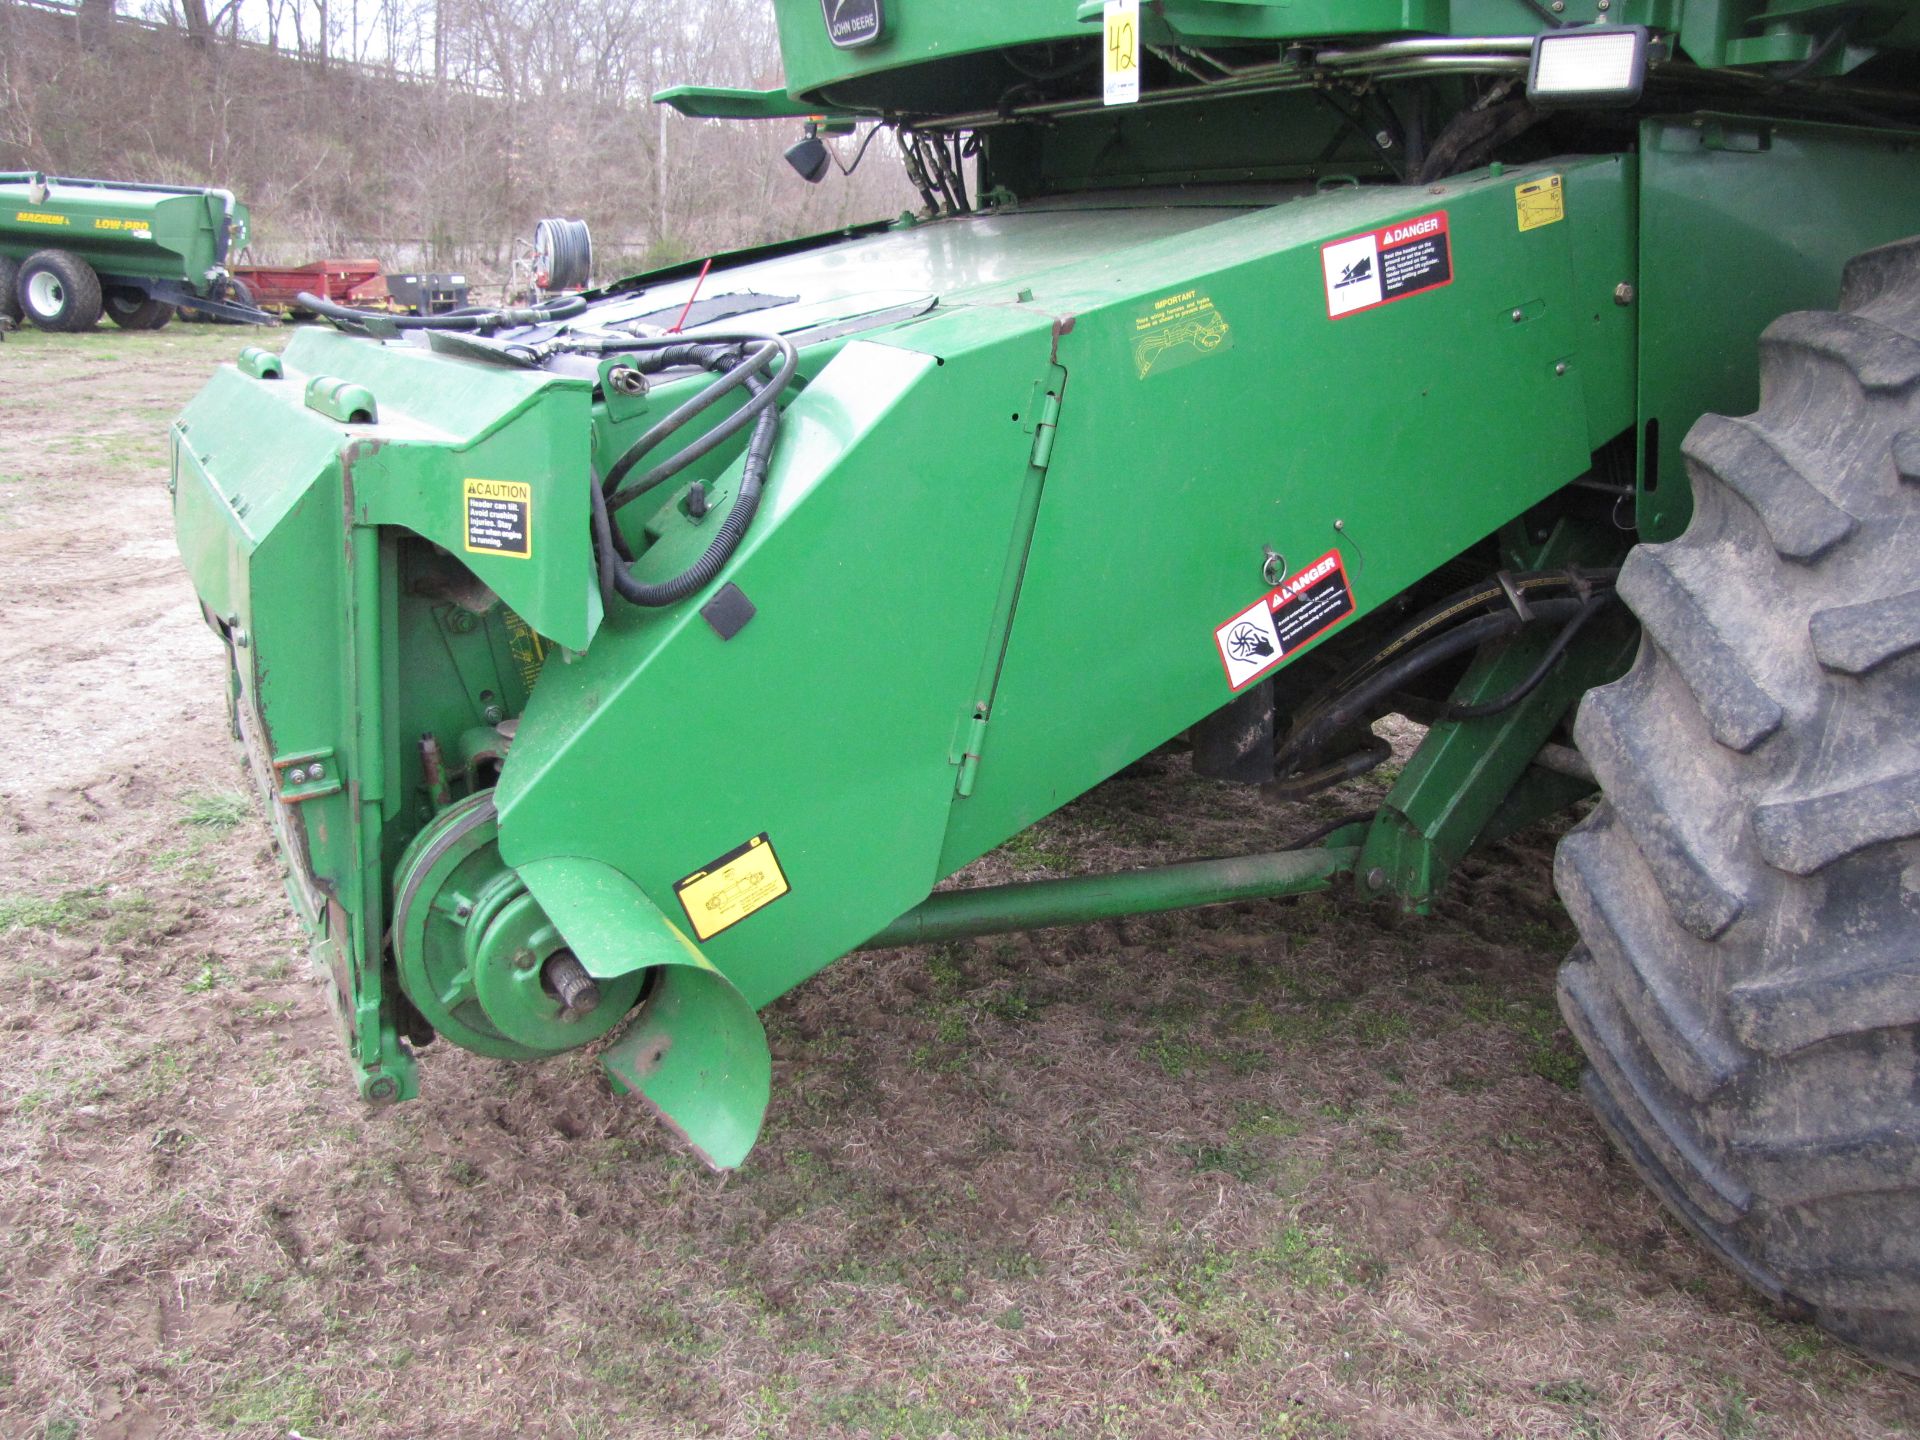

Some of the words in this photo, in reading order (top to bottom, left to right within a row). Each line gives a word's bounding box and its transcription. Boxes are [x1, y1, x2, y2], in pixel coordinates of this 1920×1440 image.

[833, 20, 851, 37] JOHN
[851, 13, 875, 31] DEERE
[1109, 22, 1137, 72] 42
[16, 212, 65, 225] MAGNUM
[95, 219, 149, 231] LOW-PRO
[1394, 218, 1439, 242] DANGER
[1403, 246, 1418, 254] header
[1385, 257, 1401, 267] ground
[1397, 260, 1414, 269] located
[1386, 276, 1401, 285] before
[1402, 271, 1417, 281] getting
[1154, 290, 1196, 310] IMPORTANT
[476, 482, 527, 499] CAUTION
[470, 498, 493, 509] Header
[494, 502, 507, 510] can
[507, 502, 520, 512] tilt.
[470, 508, 489, 517] Avoid
[489, 511, 518, 522] crushing
[497, 520, 512, 531] Stay
[470, 527, 484, 535] clear
[485, 528, 502, 537] when
[501, 530, 523, 540] engine
[470, 535, 477, 543] is
[477, 537, 503, 548] running.
